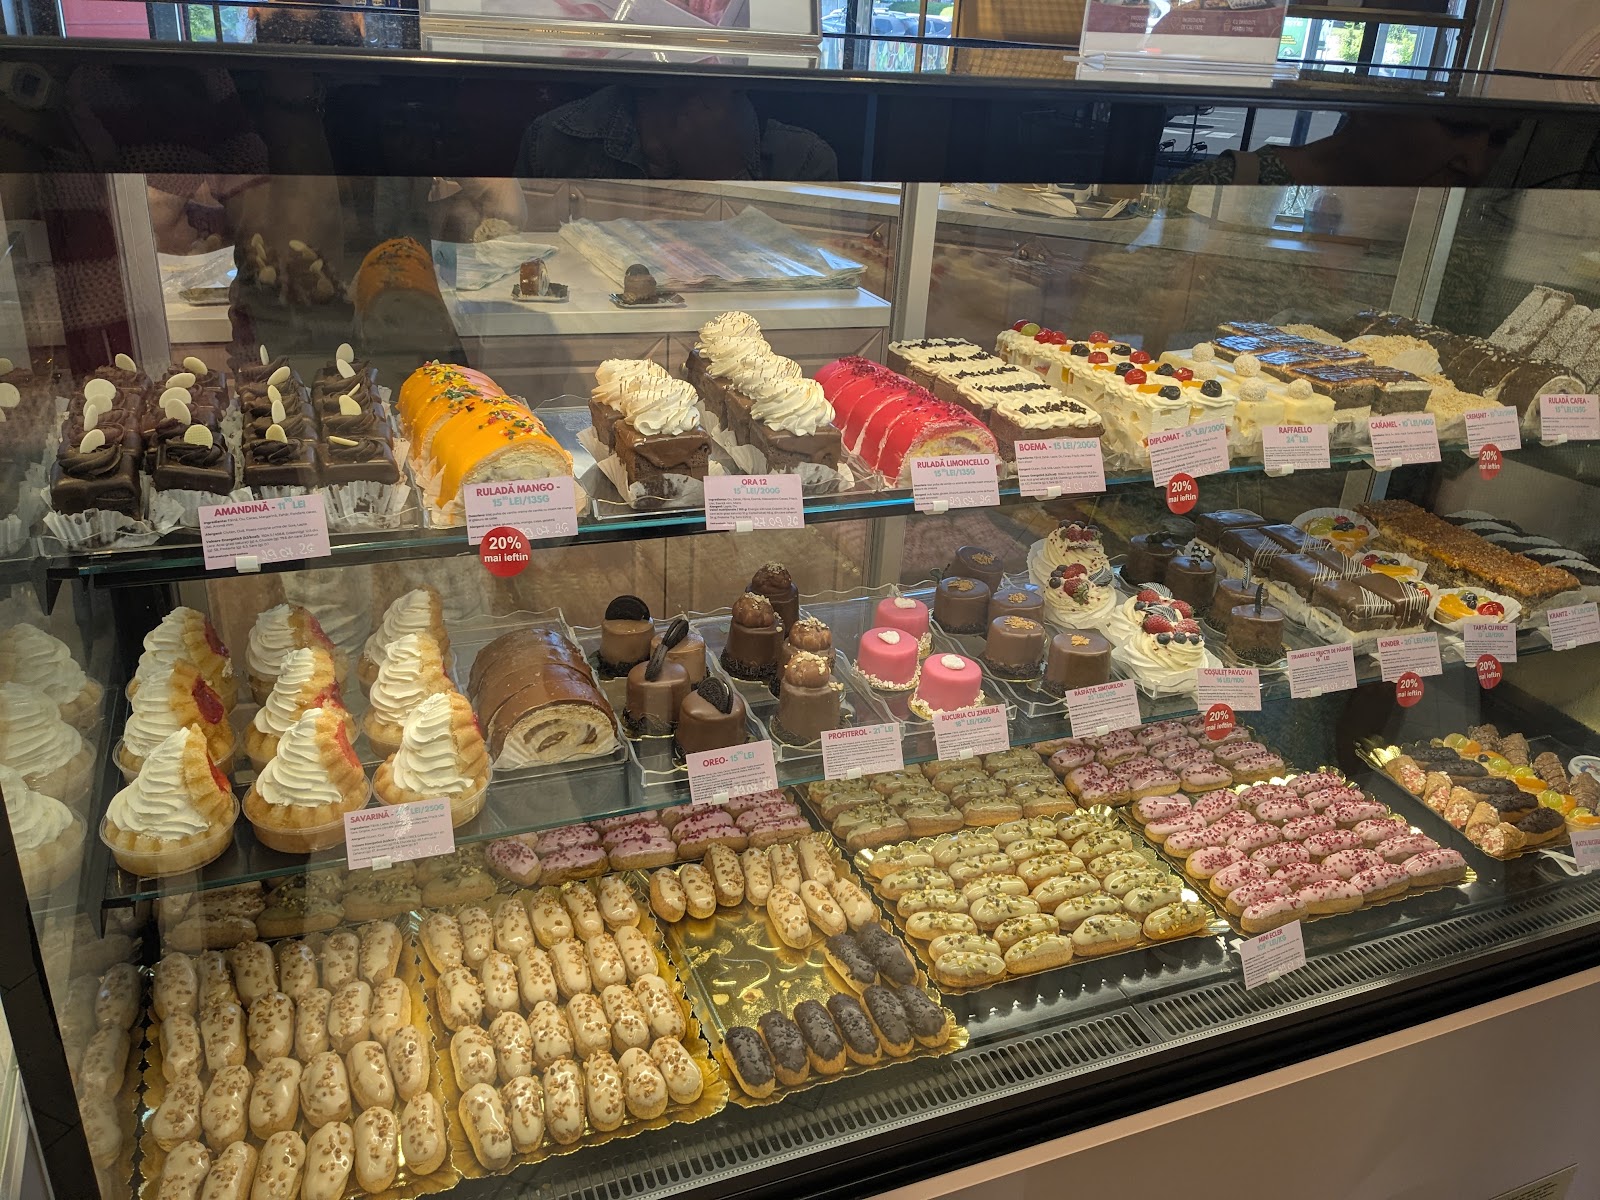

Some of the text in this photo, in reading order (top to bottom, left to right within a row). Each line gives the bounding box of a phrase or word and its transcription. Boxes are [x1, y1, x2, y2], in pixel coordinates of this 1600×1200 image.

[1278, 426, 1313, 434] RAFFAELLO
[1149, 432, 1180, 446] DIPLOMAT
[1018, 442, 1048, 451] BOEMA
[1481, 450, 1498, 461] 20%
[916, 458, 990, 469] RULADĂ LIMONCELLO
[741, 478, 768, 486] ORA 12
[1171, 480, 1192, 493] 20%
[476, 483, 516, 497] RULADĂ
[516, 482, 555, 494] MANGO
[509, 494, 550, 506] LEI/135G
[214, 501, 270, 517] AMANDINĂ
[293, 499, 306, 509] LEI
[488, 536, 522, 550] 20%
[484, 552, 529, 563] mai ieftin
[1380, 640, 1400, 648] KINDER
[1479, 660, 1496, 671] 20%
[1400, 678, 1418, 689] 20%
[941, 706, 1000, 721] BUCURIA CU ZMEURĂ
[1209, 709, 1229, 722] 20%
[828, 728, 868, 740] PROFITEROL
[884, 725, 894, 733] LEI
[743, 751, 755, 760] LEI
[350, 809, 390, 824] SAVARINĂ
[410, 803, 445, 815] LEI/250G
[1258, 928, 1283, 944] MINI ECLER
